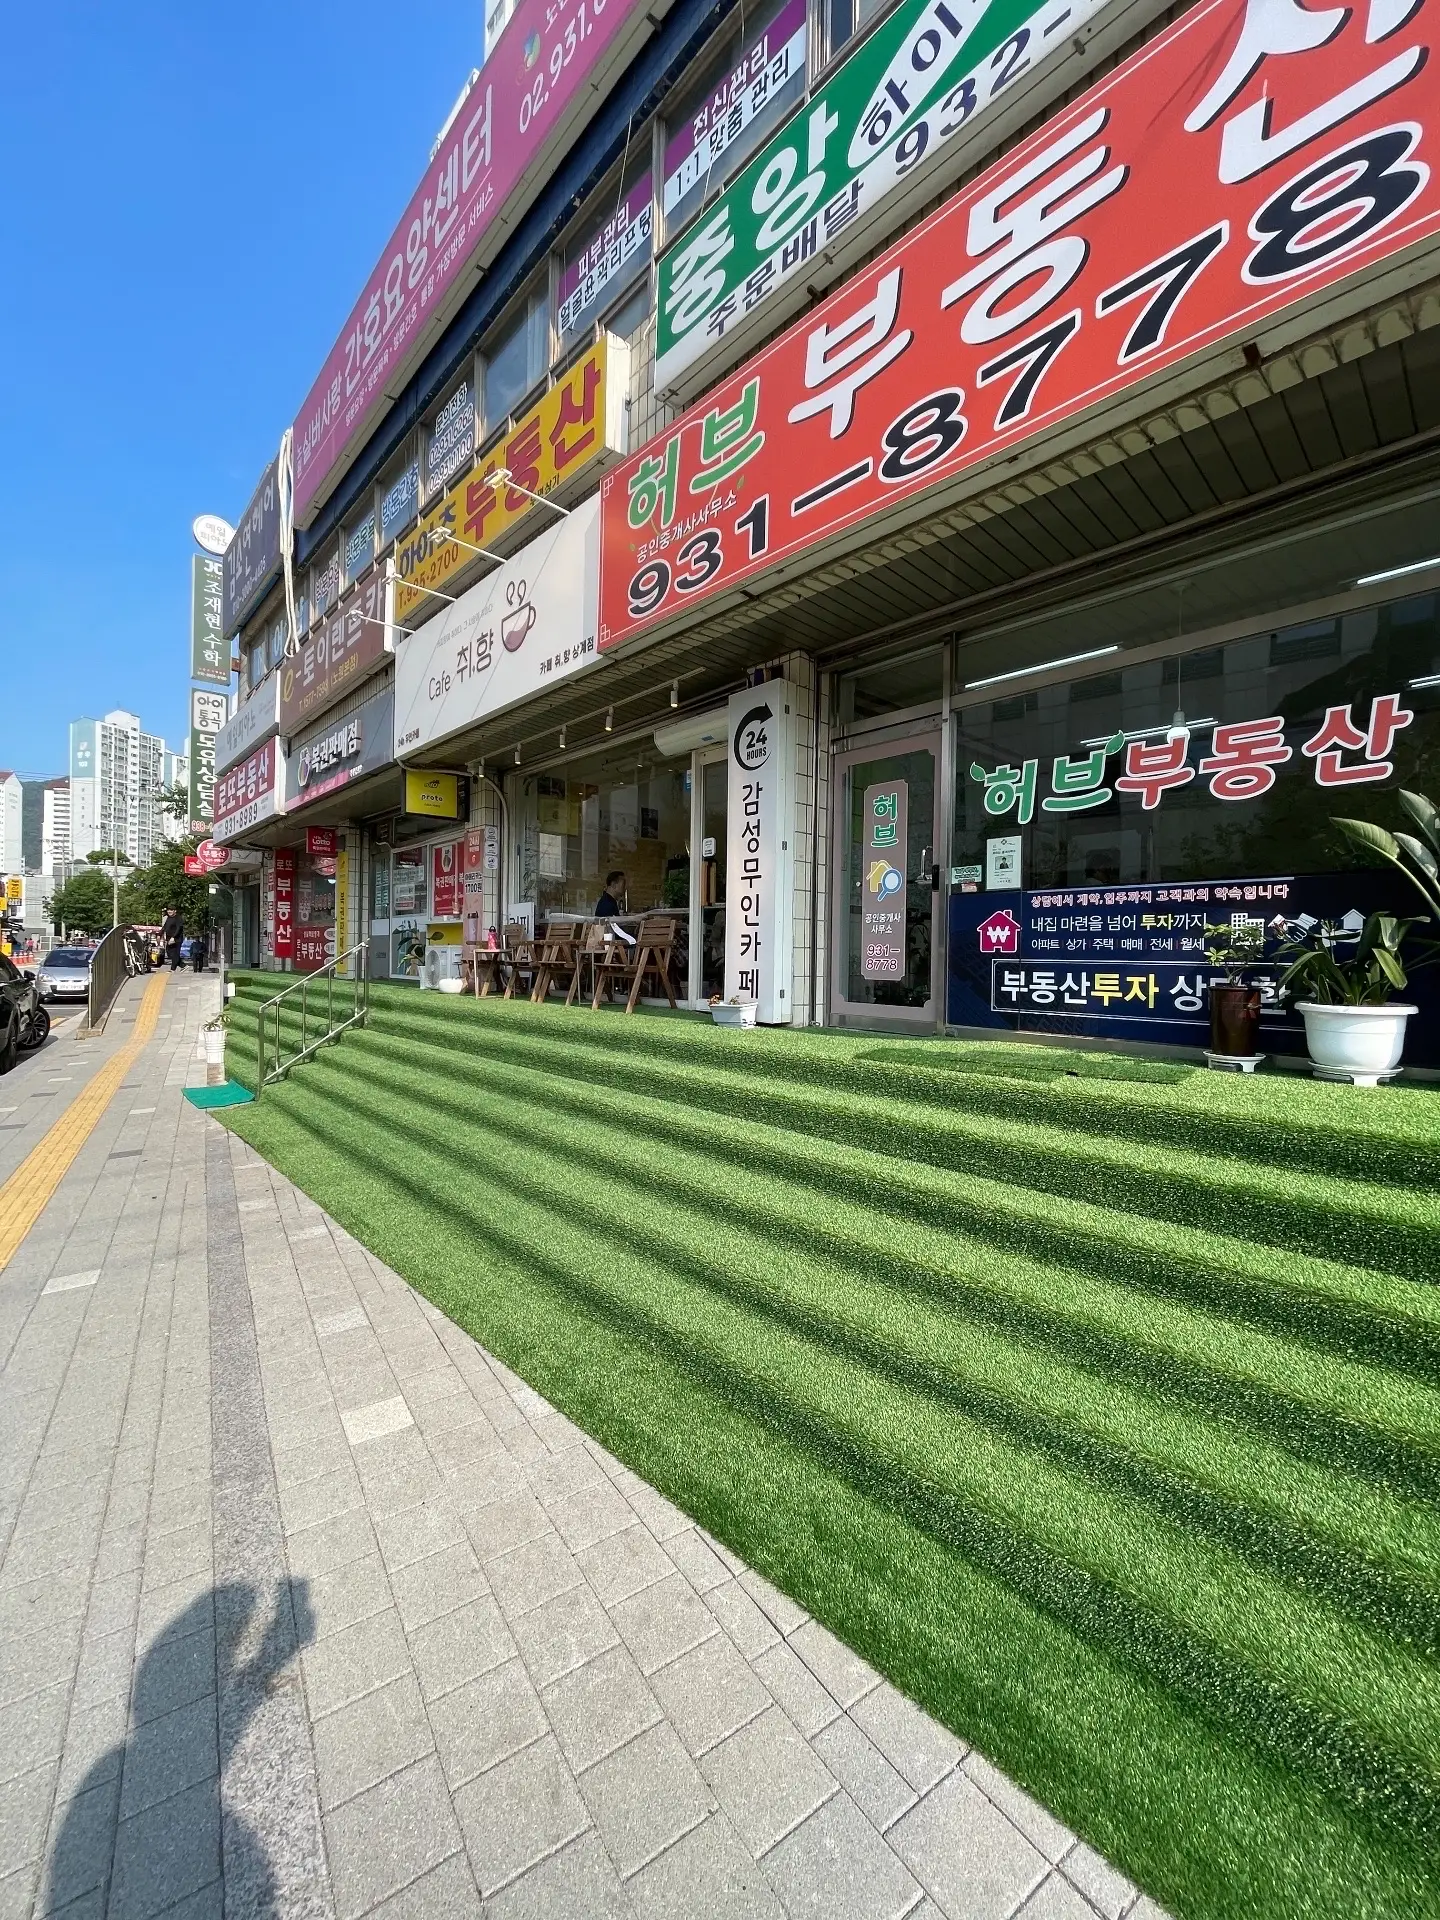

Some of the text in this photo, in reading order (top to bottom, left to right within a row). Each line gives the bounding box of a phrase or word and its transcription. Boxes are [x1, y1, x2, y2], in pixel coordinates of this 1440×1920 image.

[693, 34, 769, 146] 전신관리
[675, 46, 790, 197] 1:1 맞춤 관리
[345, 83, 493, 397] 간호요양센터
[436, 223, 466, 283] 가정방문
[468, 182, 494, 232] 서비스
[577, 202, 631, 278] 피부관리
[665, 100, 839, 335] 중앙
[627, 0, 1429, 530] 허브 부동산
[706, 178, 865, 337] 주문배달
[626, 120, 1431, 619] 931-8778
[436, 381, 468, 438] 문의전화
[463, 357, 601, 543] 부동산
[382, 462, 419, 528] 방문간호
[200, 531, 229, 548] 피아노
[205, 522, 226, 538] 예일
[636, 490, 738, 564] 공인중개사사무소
[203, 580, 222, 630] 조재현
[203, 632, 222, 667] 수학
[539, 655, 553, 677] 카페
[572, 636, 595, 660] 상계점
[197, 696, 224, 709] 아이
[428, 670, 451, 701] Cafe
[198, 709, 222, 730] 통곡
[745, 730, 768, 750] 24
[311, 718, 361, 773] 복권판매점
[746, 746, 767, 761] HOURS
[196, 733, 218, 818] 모유상담실
[217, 747, 270, 816] 로또부동산
[421, 794, 443, 802] proto
[870, 792, 899, 848] 허브
[276, 859, 293, 943] 로또 부동산
[738, 780, 764, 1000] 감성무인카페
[1031, 894, 1074, 908] 상담에서
[1155, 887, 1209, 902] 고객과의
[1214, 884, 1290, 900] 약속입니다
[864, 912, 902, 924] 공인중개사
[870, 924, 893, 935] 사무소
[1031, 912, 1208, 932] 내집 마련을 넘어 투자까지
[301, 942, 323, 960] 부동산
[865, 957, 898, 972] 8778
[866, 944, 901, 957] 931-
[1031, 938, 1205, 951] 아파트 상가 주택 매매 전세 월세
[1000, 971, 1160, 1009] 부동산투자
